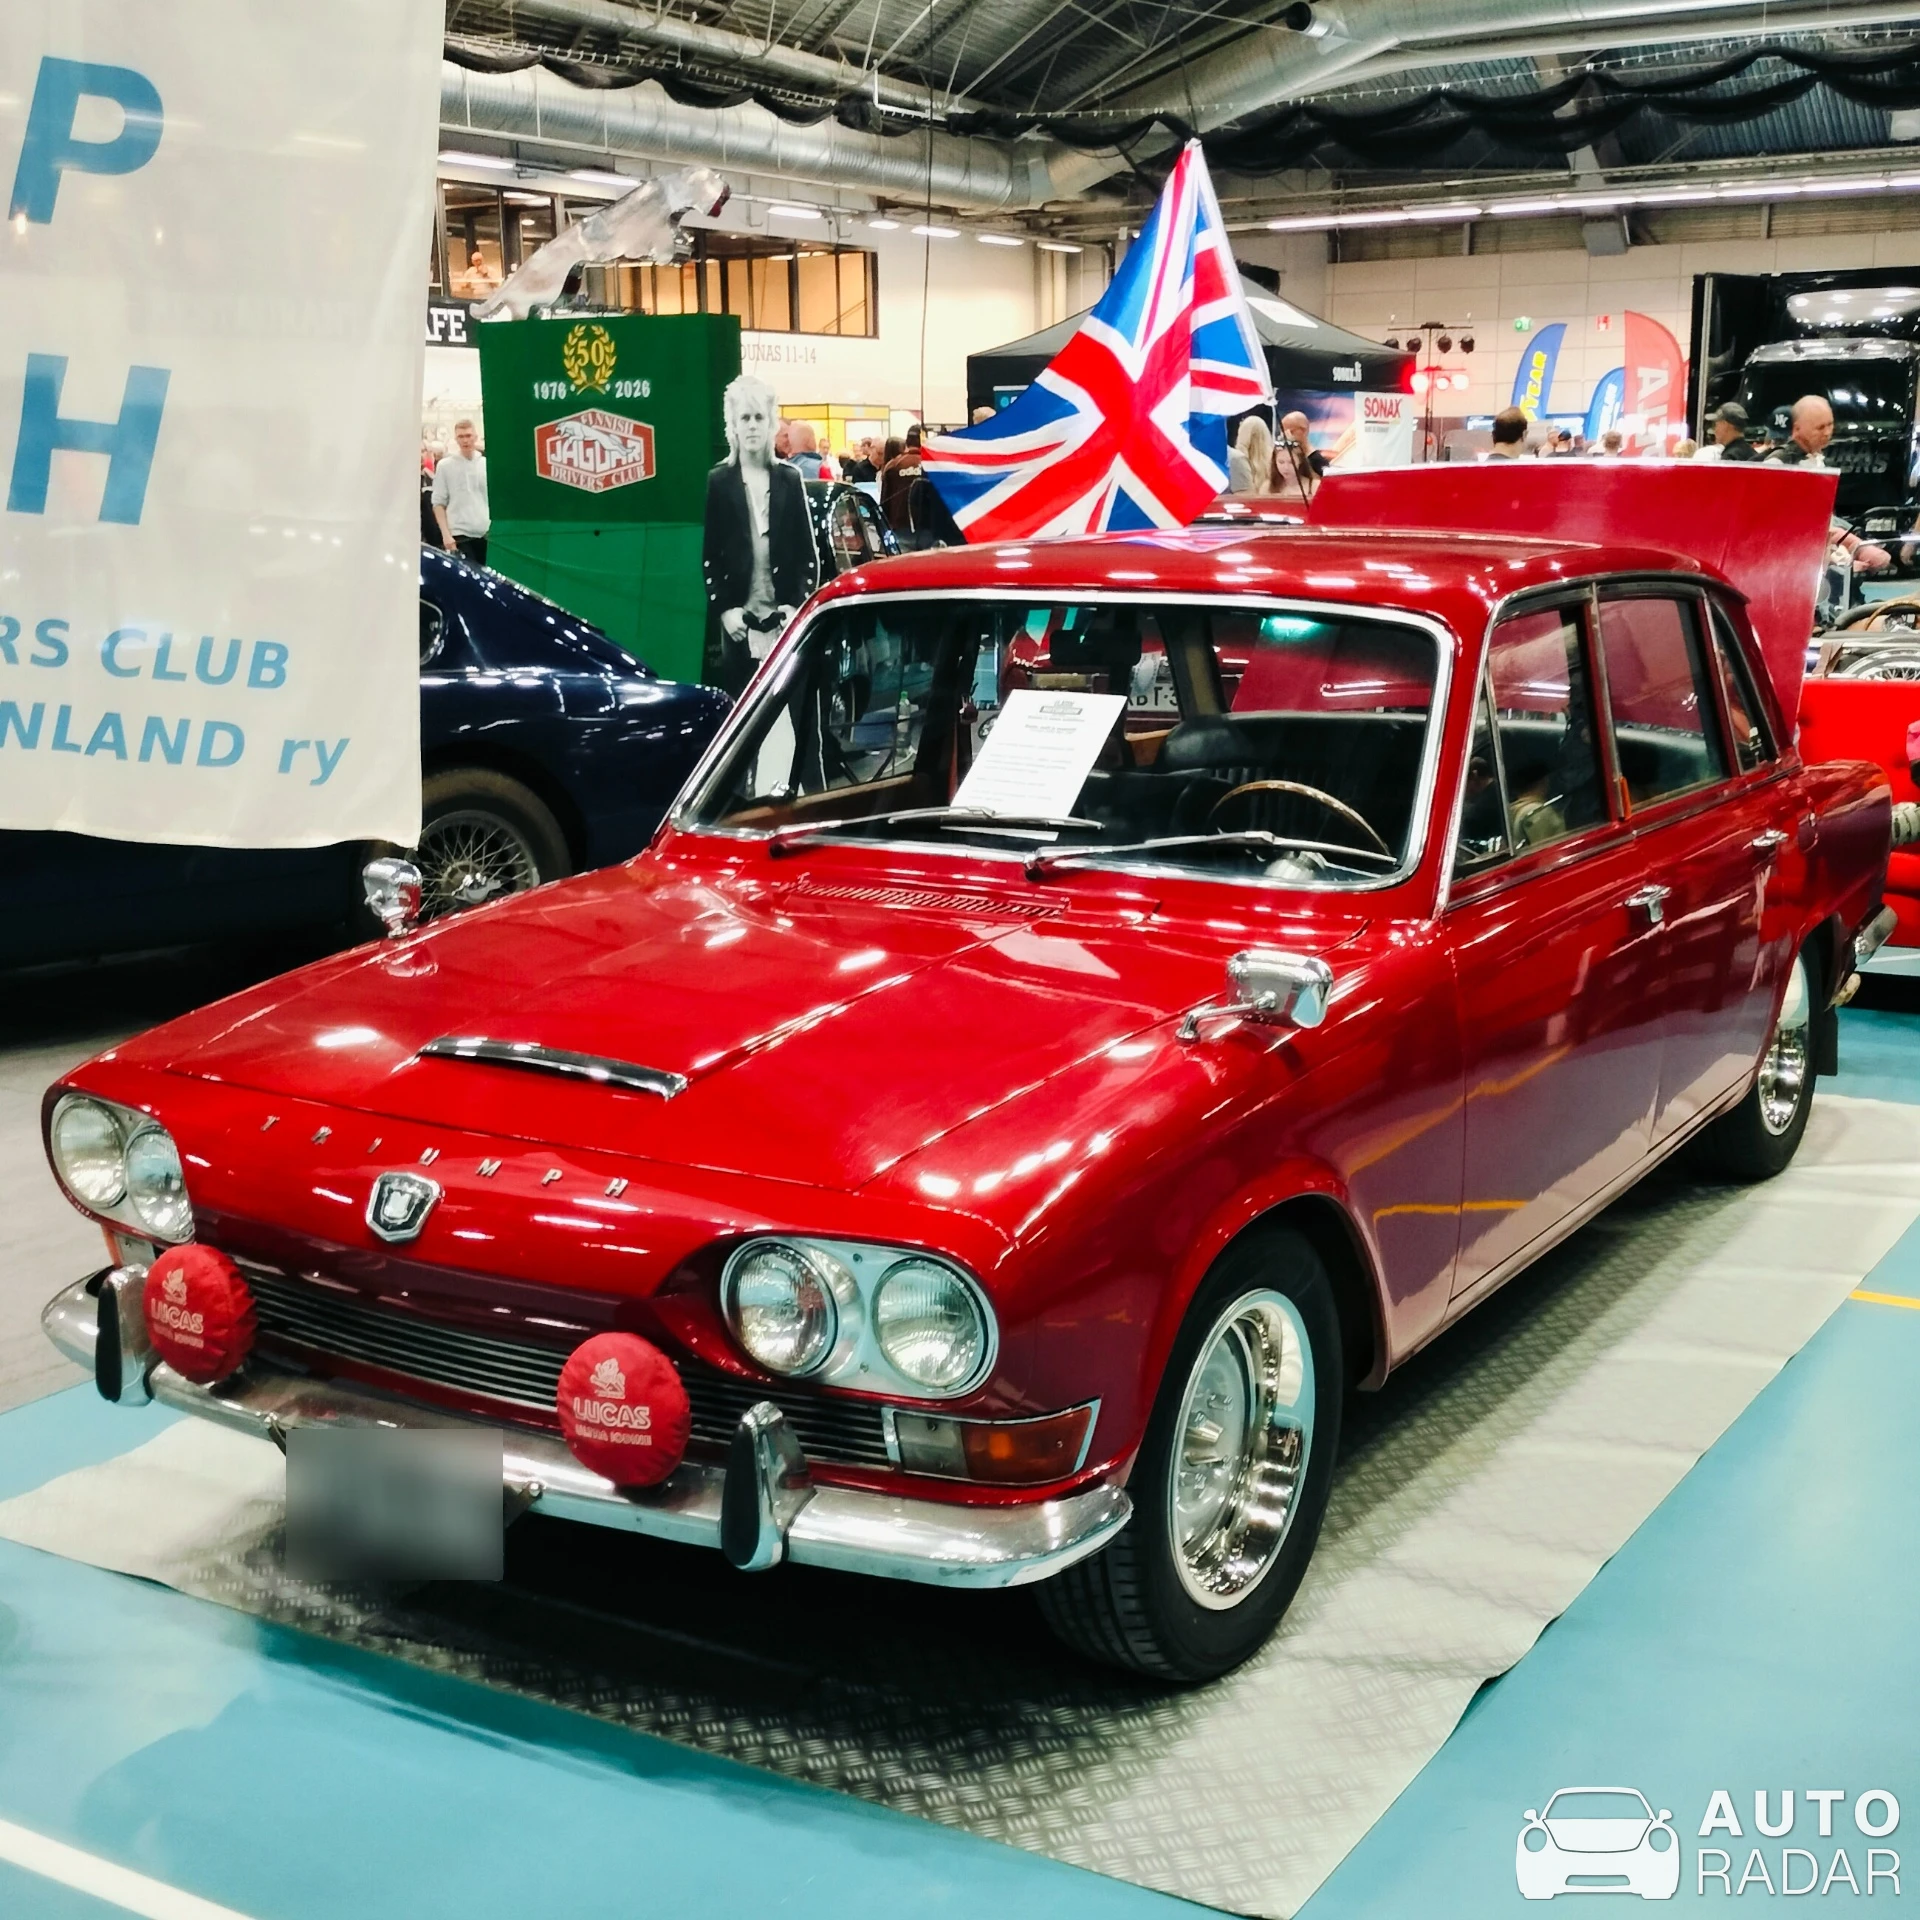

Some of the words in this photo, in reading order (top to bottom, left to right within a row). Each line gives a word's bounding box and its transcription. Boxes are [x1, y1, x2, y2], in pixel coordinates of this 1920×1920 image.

[7, 56, 165, 224] P
[425, 307, 467, 343] FE
[576, 339, 605, 367] 50
[786, 345, 816, 364] 11-14
[533, 381, 567, 400] 1976
[615, 379, 651, 399] 2026
[580, 412, 634, 436] FINNISH
[1364, 397, 1402, 418] SONAX
[7, 353, 171, 526] H
[549, 438, 642, 474] JAGUAR
[611, 464, 646, 486] CLUB
[100, 627, 290, 690] CLUB
[278, 737, 351, 787] ry
[260, 1114, 629, 1199] TRIUMPH
[150, 1297, 204, 1335] LUCAS
[573, 1396, 652, 1431] LUCAS
